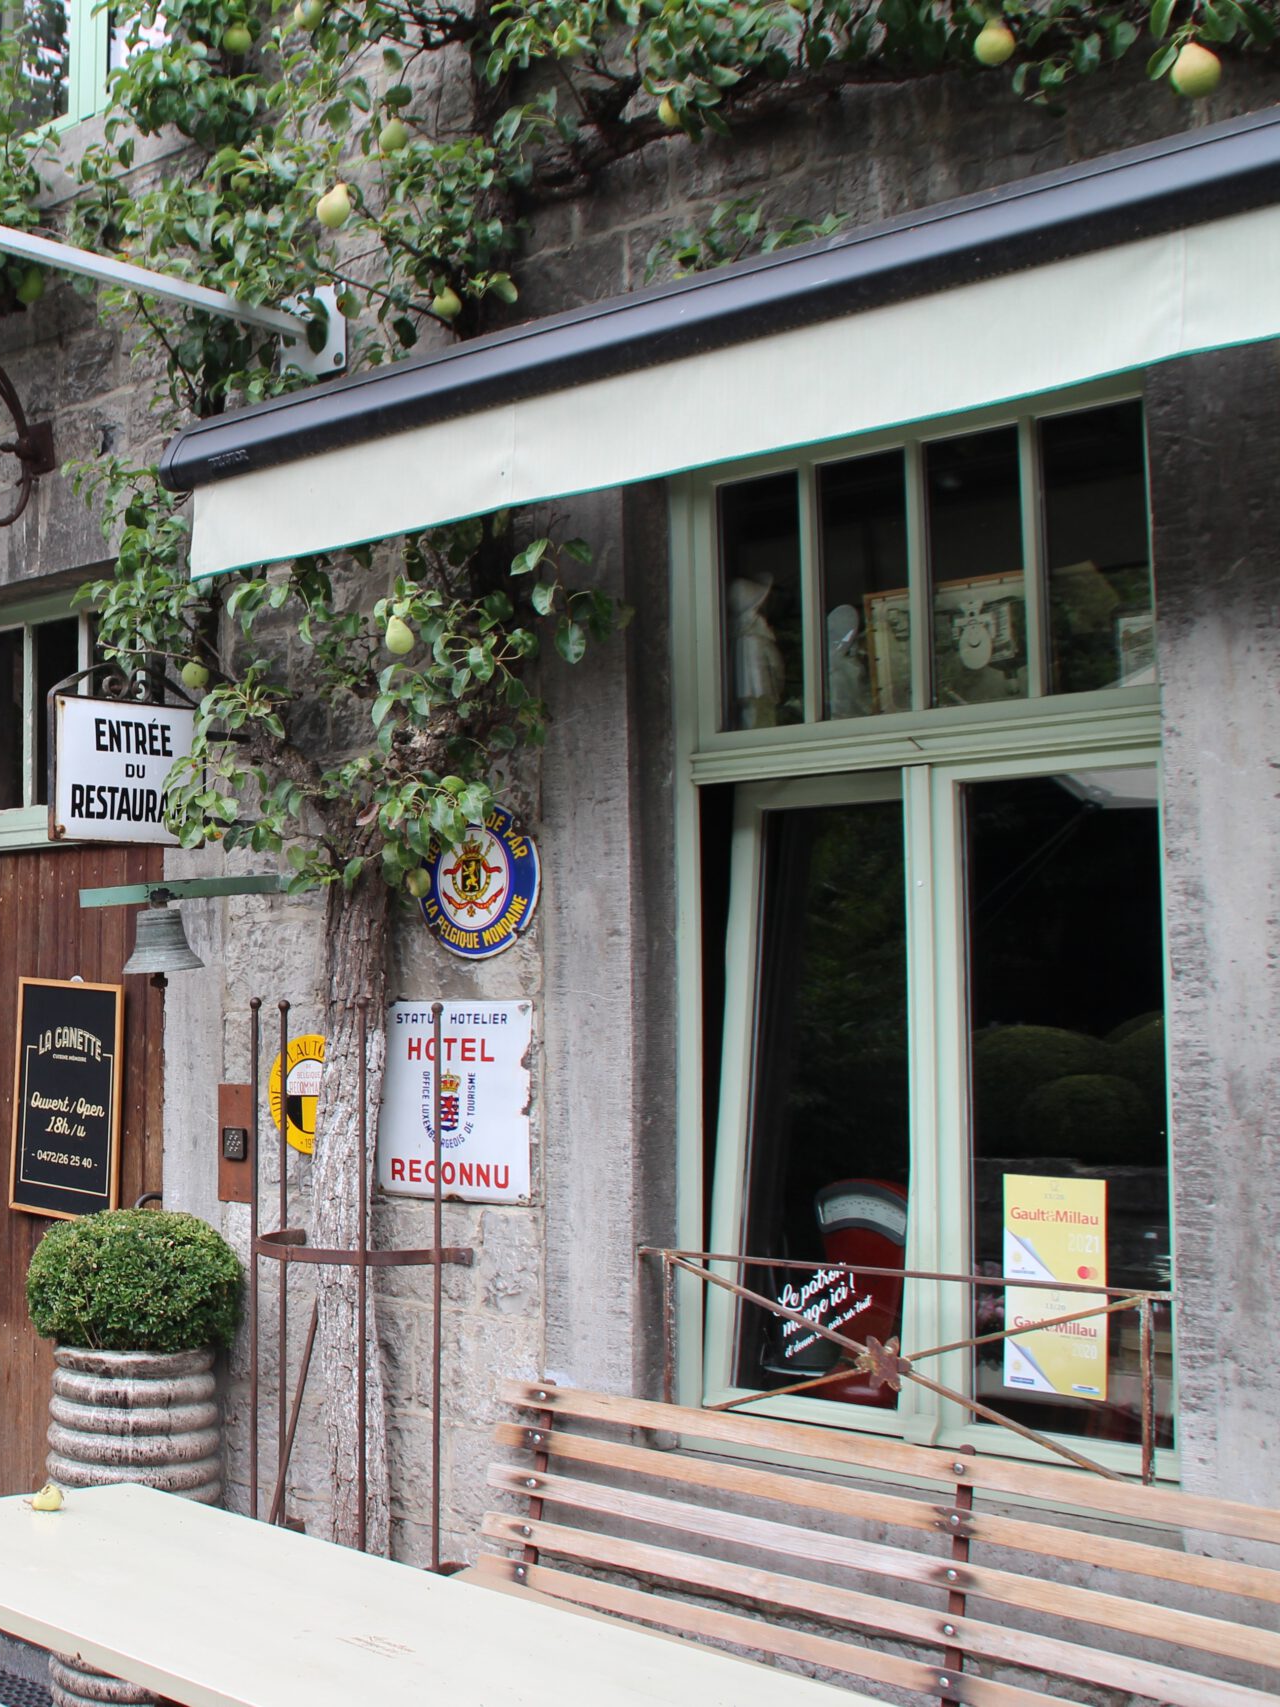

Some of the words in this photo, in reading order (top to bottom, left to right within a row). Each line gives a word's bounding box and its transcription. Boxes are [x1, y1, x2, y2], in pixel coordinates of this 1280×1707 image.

[95, 718, 173, 757] ENTRÉE
[125, 763, 146, 779] DU
[71, 783, 189, 824] RESTAURA
[425, 897, 439, 918] LA
[482, 894, 528, 947] MONDAINE
[396, 1013, 442, 1024] STATU
[450, 1013, 508, 1025] HOTELIER
[38, 1029, 52, 1055] LA
[55, 1026, 102, 1062] CANETTE
[407, 1037, 495, 1062] HOTEL
[289, 1081, 320, 1095] RECOMMA
[422, 1071, 431, 1100] OFFICE
[466, 1072, 476, 1116] TOURISME
[31, 1091, 70, 1114] Ouvert
[76, 1097, 105, 1119] Open
[421, 1104, 465, 1149] LUXEMBRGEOIS
[464, 1121, 475, 1134] DE
[37, 1149, 69, 1165] 0472/26
[70, 1155, 80, 1167] 25
[81, 1157, 92, 1169] 40
[391, 1158, 510, 1189] RECONNU
[1067, 1233, 1100, 1254] 2021
[775, 1284, 802, 1313] Le
